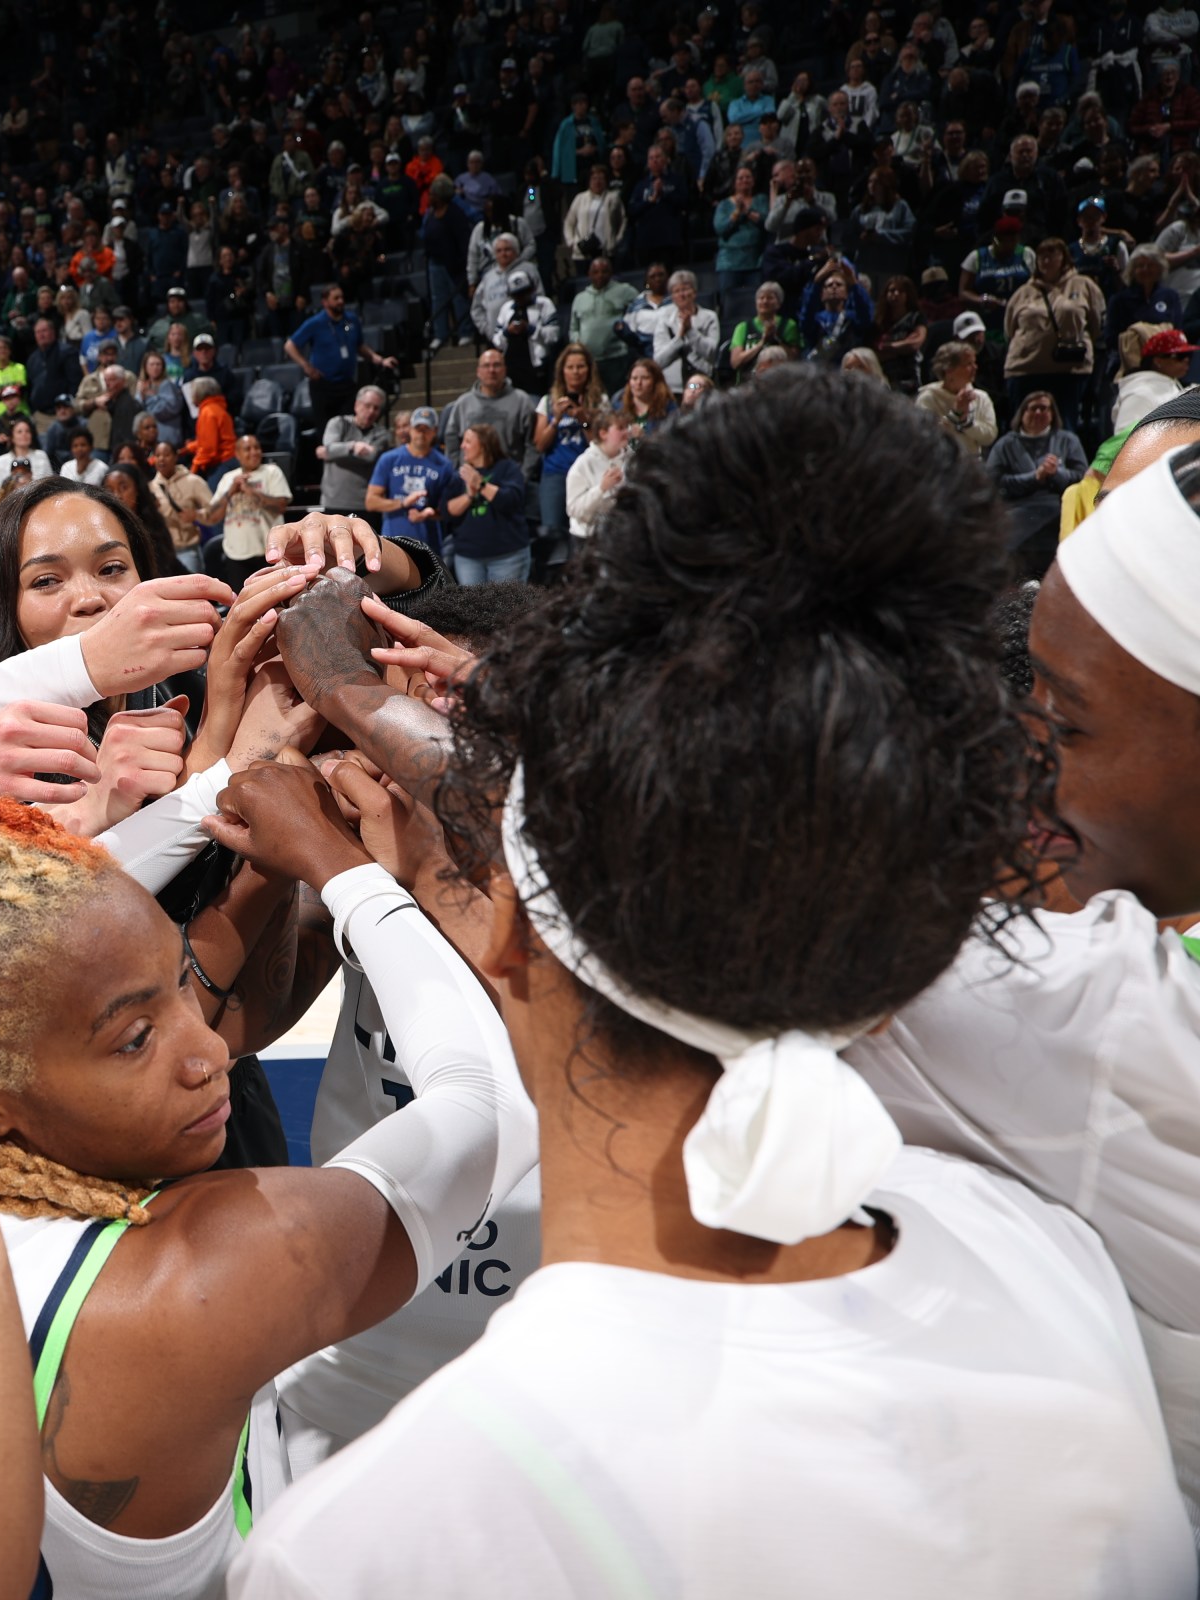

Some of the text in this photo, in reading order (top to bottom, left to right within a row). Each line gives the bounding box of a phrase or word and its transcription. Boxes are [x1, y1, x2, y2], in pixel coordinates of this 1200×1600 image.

[996, 276, 1013, 291] 21
[559, 428, 582, 445] 24
[392, 465, 439, 480] SAY IT TO
[467, 1220, 498, 1250] O
[434, 1259, 511, 1296] NIC
